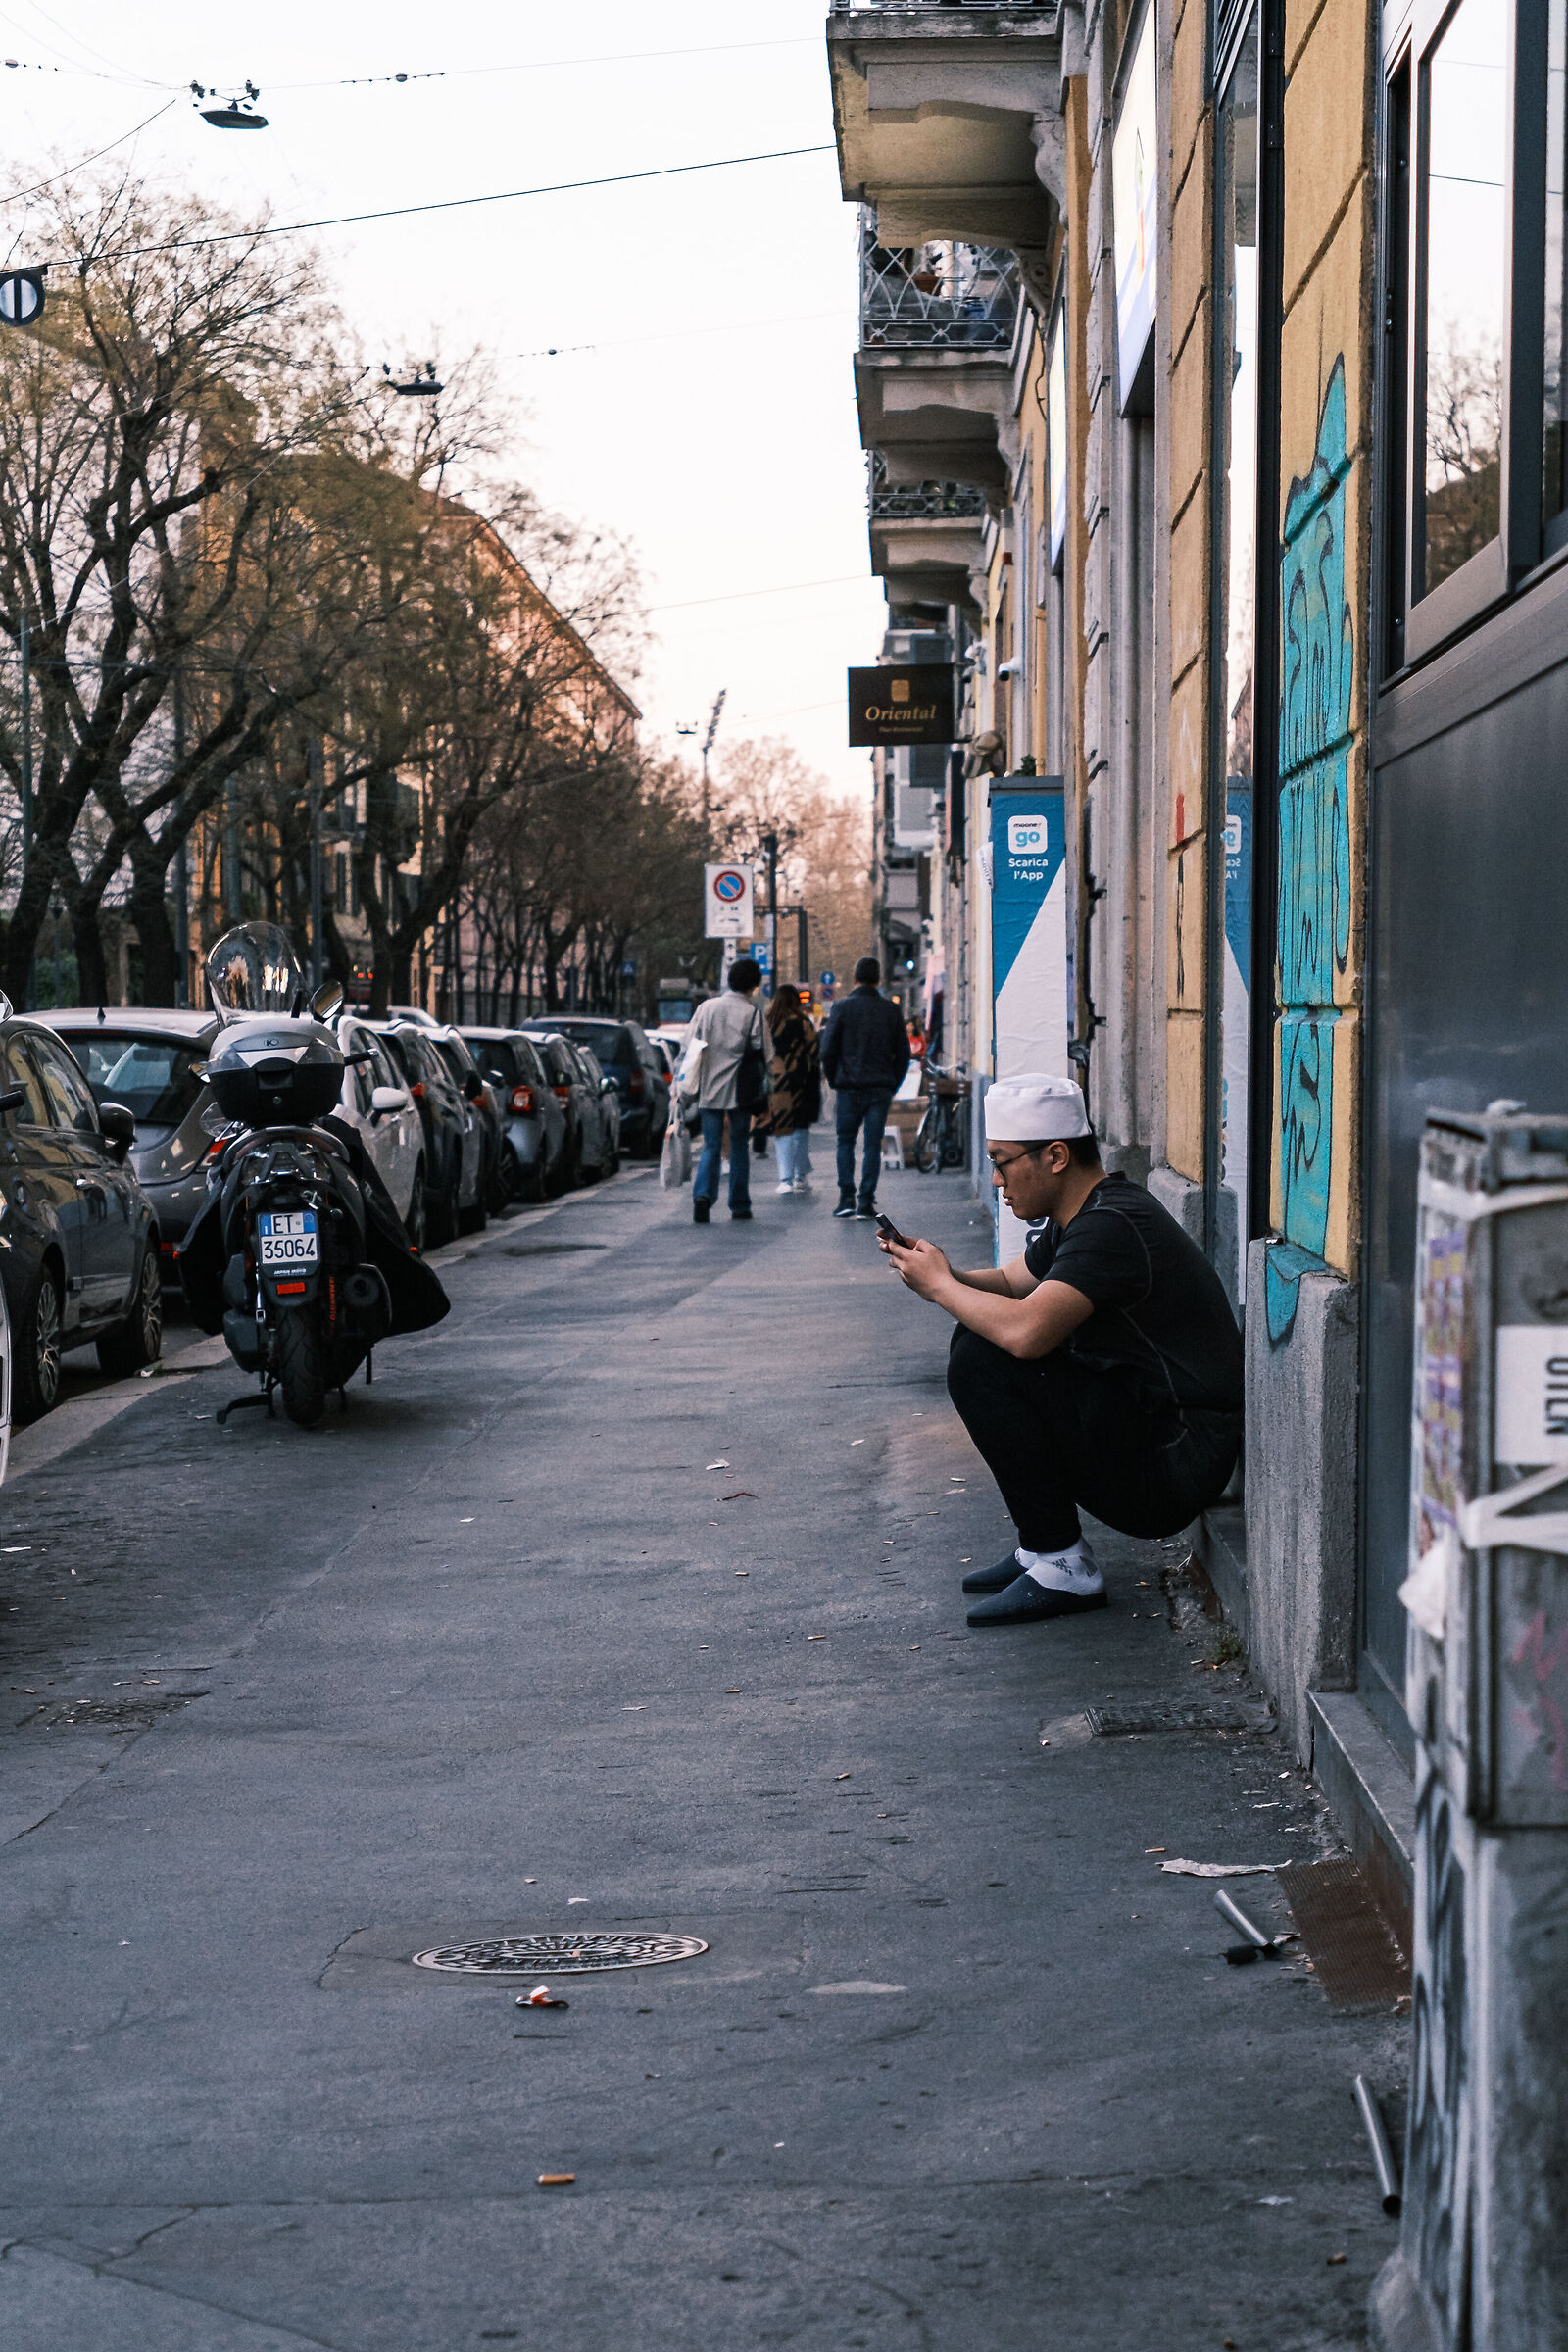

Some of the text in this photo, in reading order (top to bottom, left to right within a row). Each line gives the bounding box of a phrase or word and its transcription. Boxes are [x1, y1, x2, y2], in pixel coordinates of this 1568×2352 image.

[864, 705, 937, 721] Oriental
[1015, 831, 1041, 848] go
[1008, 858, 1049, 867] Scarica
[1013, 870, 1044, 881] l'App
[273, 1214, 293, 1234] ET
[263, 1238, 316, 1259] 35064
